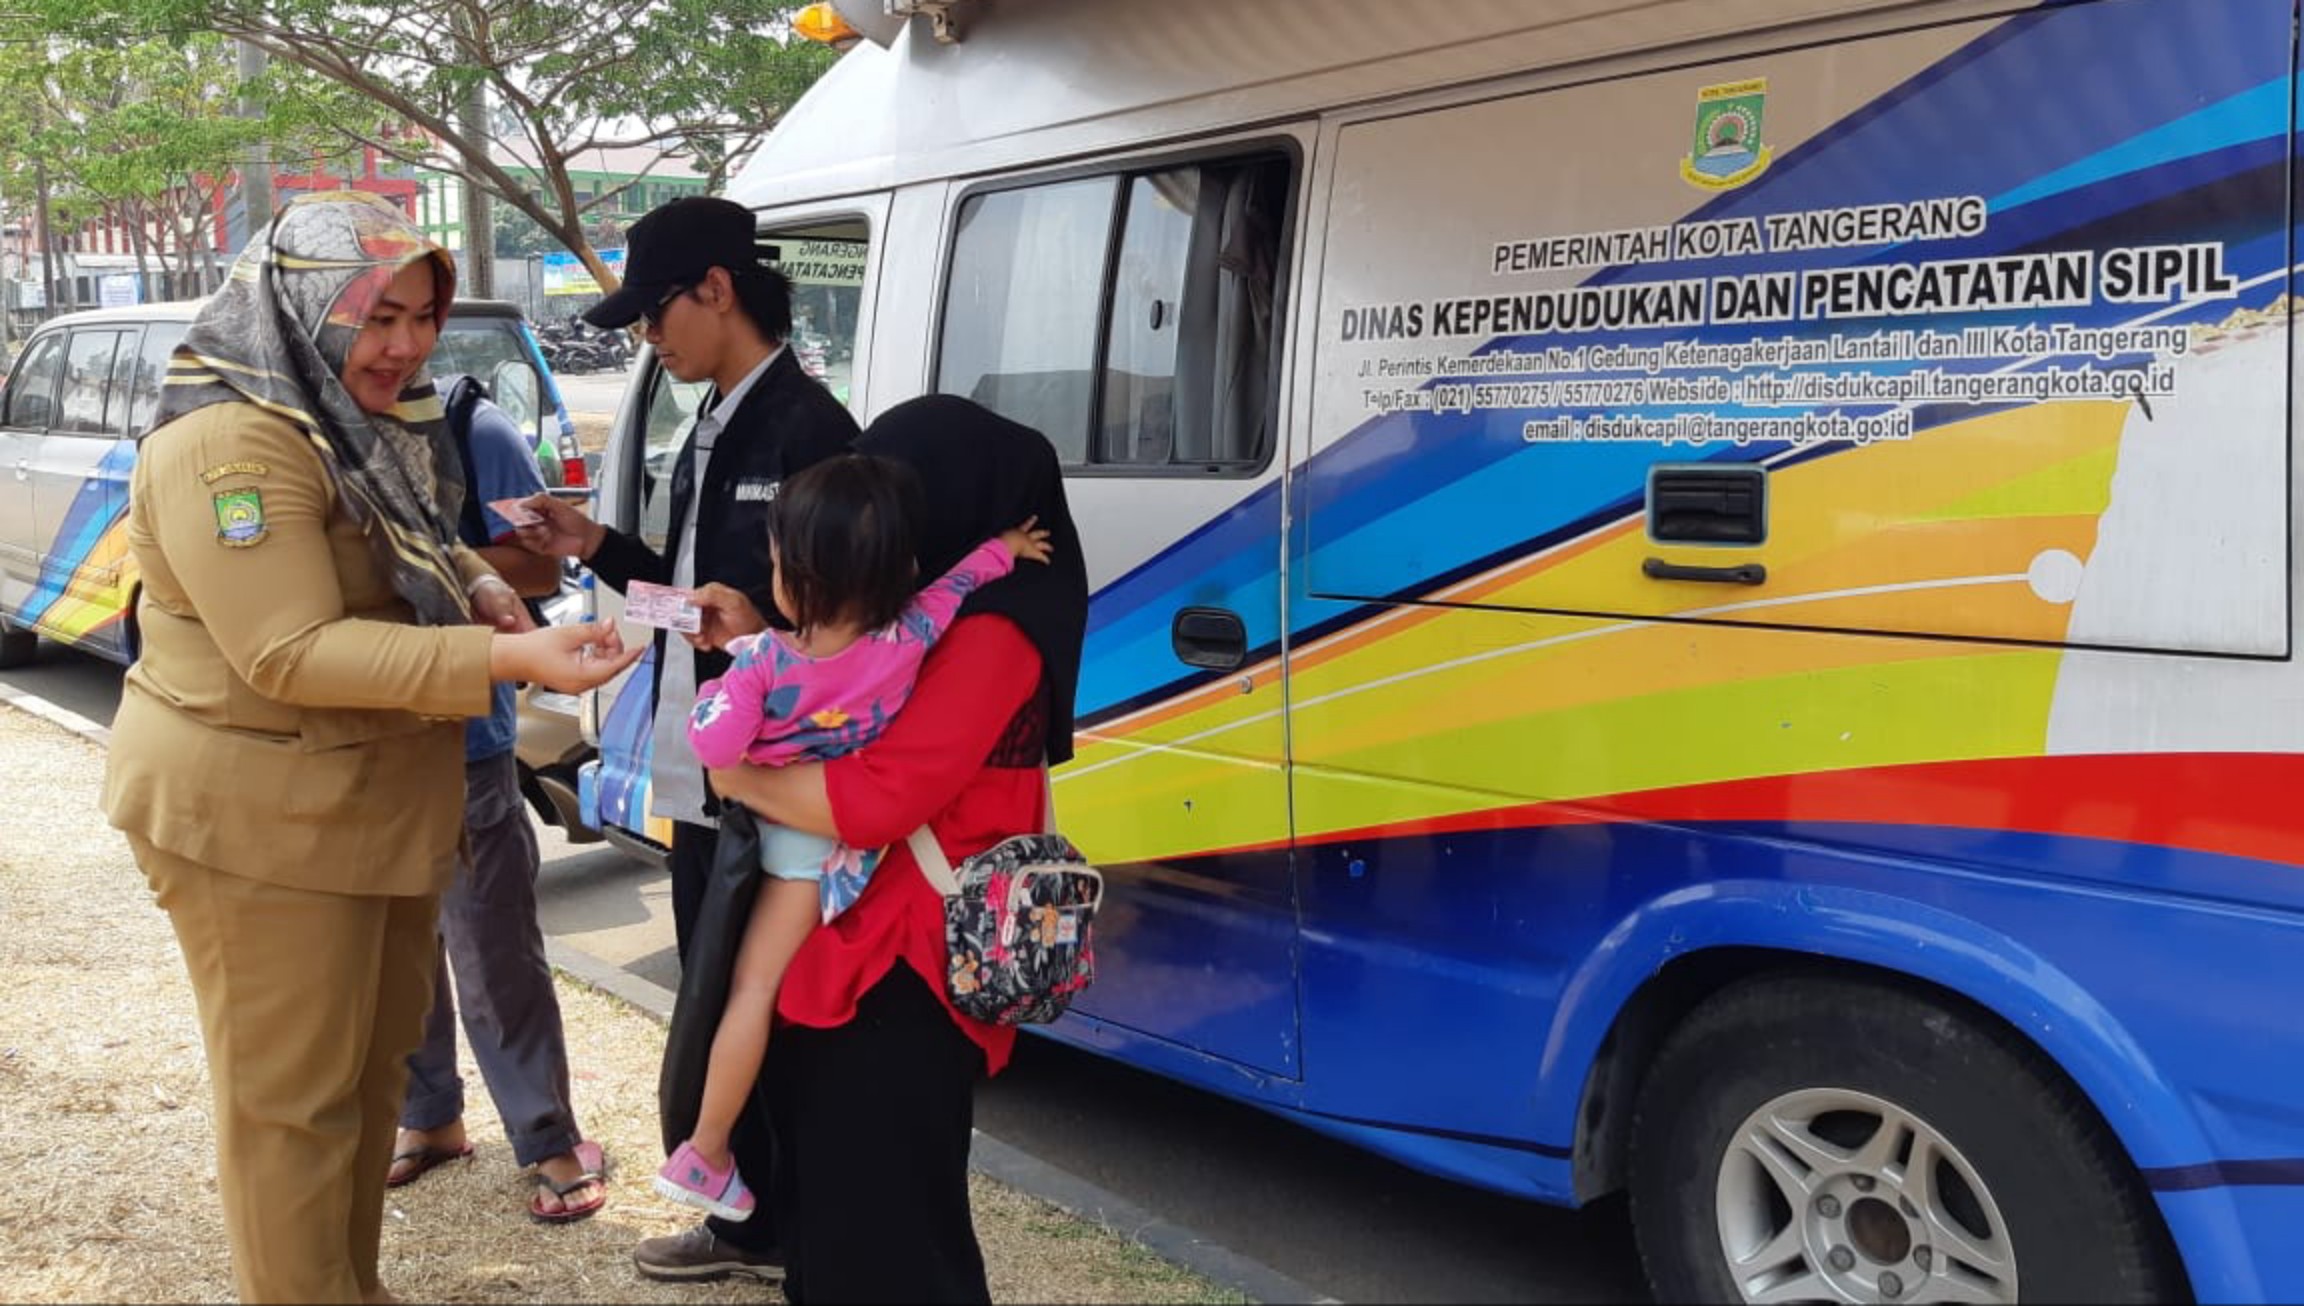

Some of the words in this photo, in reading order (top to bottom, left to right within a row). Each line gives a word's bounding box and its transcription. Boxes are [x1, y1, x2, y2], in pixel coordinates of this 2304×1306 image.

[1494, 229, 1668, 272] PEMERINTAH
[1678, 221, 1759, 255] KOTA
[1769, 199, 1982, 248] TANGERANG
[1341, 303, 1423, 341] DINAS
[1433, 283, 1702, 336] KEPENDUDUKAN
[1715, 277, 1791, 319] DAN
[1804, 255, 2087, 315] PENCATATAN
[2105, 247, 2231, 298] SIPIL
[1379, 357, 1432, 377] Perintis
[1437, 352, 1543, 374] Kemerdekaan
[1550, 350, 1584, 371] No.1
[1591, 347, 1658, 371] Gedung
[1666, 340, 1826, 370] Ketenagakerjaan
[1834, 334, 1898, 360] Lantai
[1918, 333, 1958, 358] dan
[1967, 330, 1985, 355] III
[1994, 329, 2047, 353] Kota
[2056, 327, 2187, 357] Tangerang
[1433, 387, 1473, 412] (021)
[1476, 384, 1549, 407] 55770275
[1566, 381, 1643, 405] 55770276
[1651, 378, 1728, 402] Webside
[1749, 366, 2175, 403] http://disdukcapil.tangerangkota.go.id
[1526, 420, 1569, 439] email
[1586, 414, 1909, 443] disdukcapil@tangerangkota.go.id
